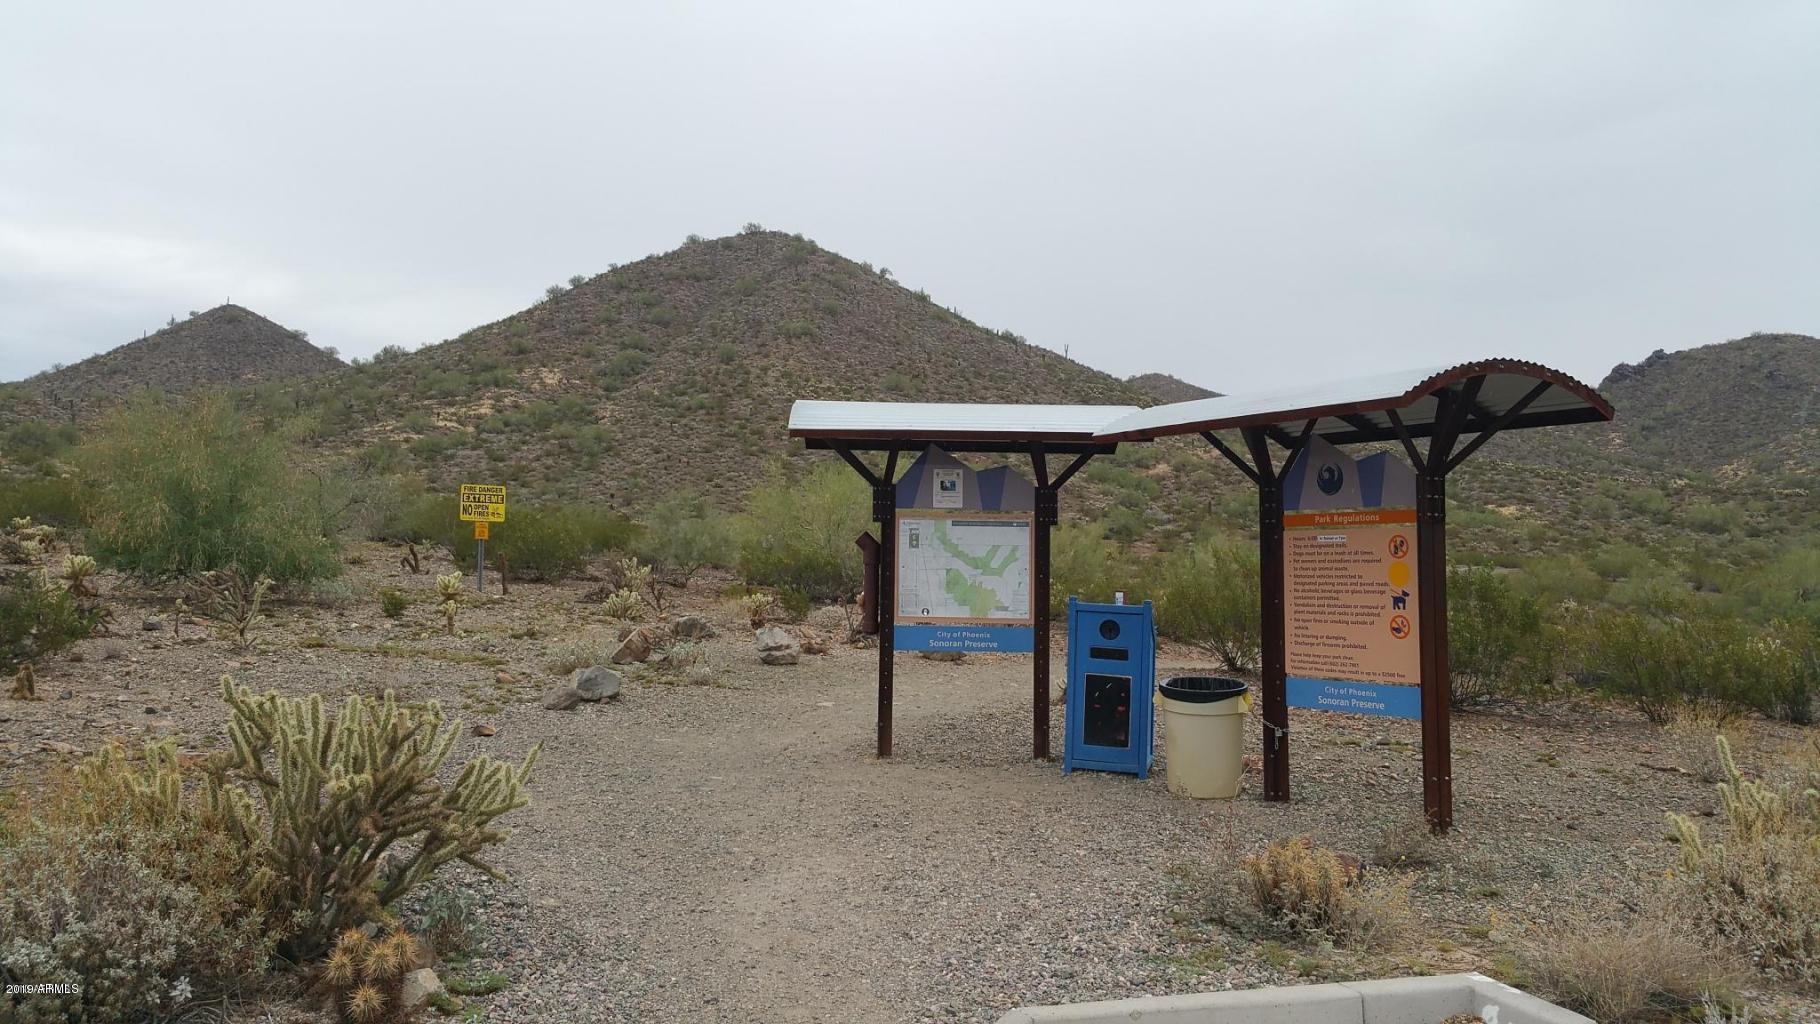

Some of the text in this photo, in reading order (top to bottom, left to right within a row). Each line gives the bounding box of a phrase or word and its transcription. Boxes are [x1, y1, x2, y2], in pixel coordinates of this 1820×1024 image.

[464, 494, 504, 503] EXTREME
[462, 504, 472, 516] NO
[1315, 513, 1380, 524] Park Regulations
[1325, 686, 1338, 695] City
[1349, 688, 1376, 697] Phoenix
[1318, 696, 1385, 710] Sonoran Preserve
